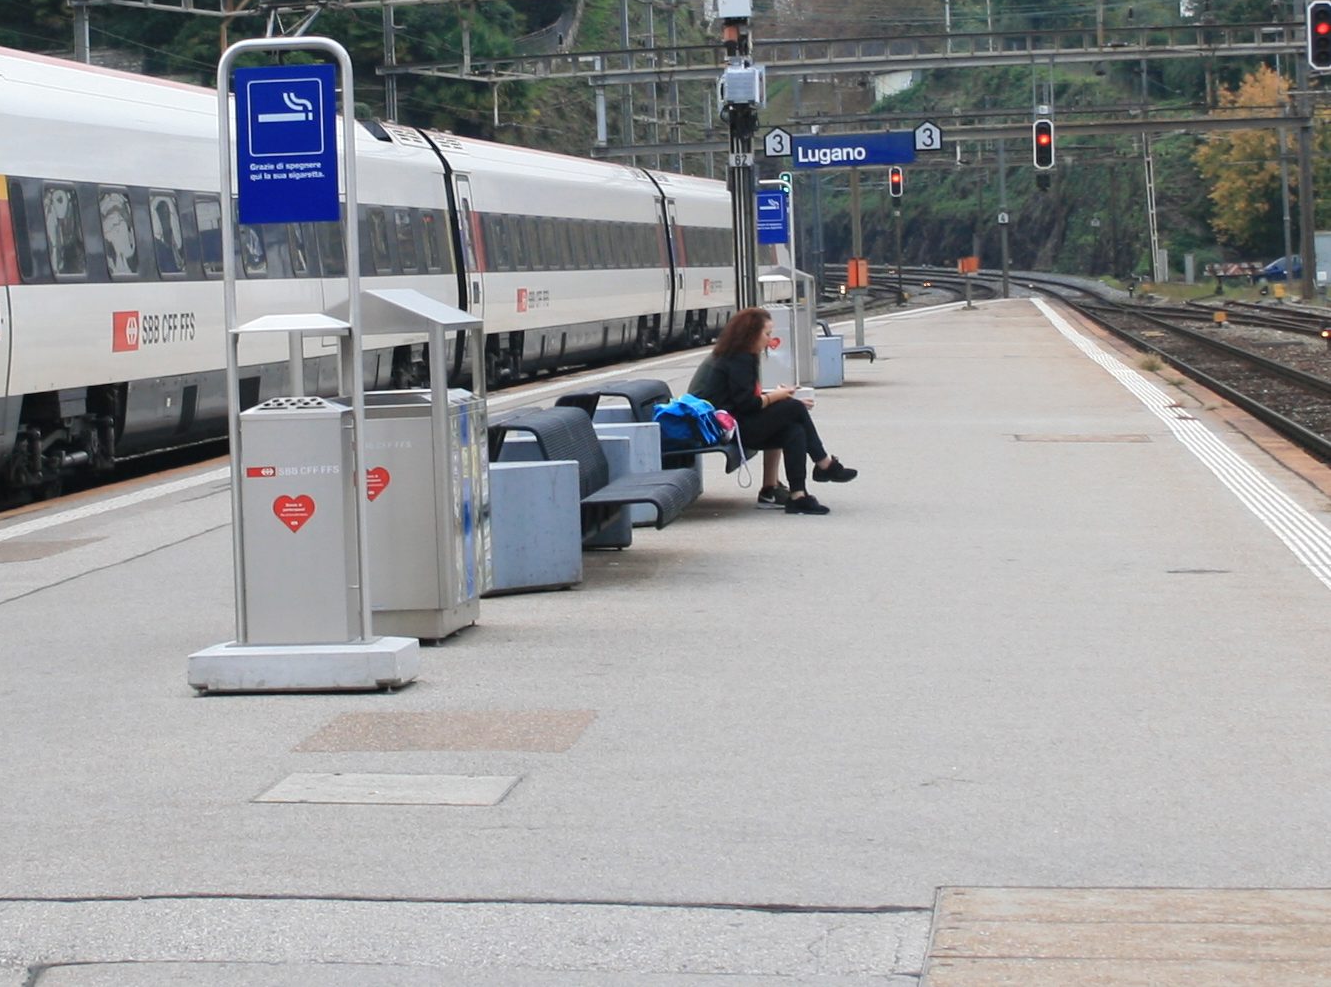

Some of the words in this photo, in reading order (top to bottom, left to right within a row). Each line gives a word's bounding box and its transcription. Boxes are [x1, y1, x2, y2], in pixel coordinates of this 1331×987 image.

[771, 133, 785, 154] 3
[921, 127, 935, 148] 3
[797, 146, 867, 165] Lugano
[250, 163, 275, 171] Grazie
[276, 162, 284, 170] di
[285, 162, 322, 171] spegnere
[250, 173, 262, 181] qui
[264, 172, 272, 180] la
[142, 314, 160, 345] SBB
[162, 313, 178, 344] CFF
[179, 312, 196, 342] FFS
[279, 466, 299, 476] SBB
[299, 465, 318, 475] CFF
[320, 464, 340, 474] FFS
